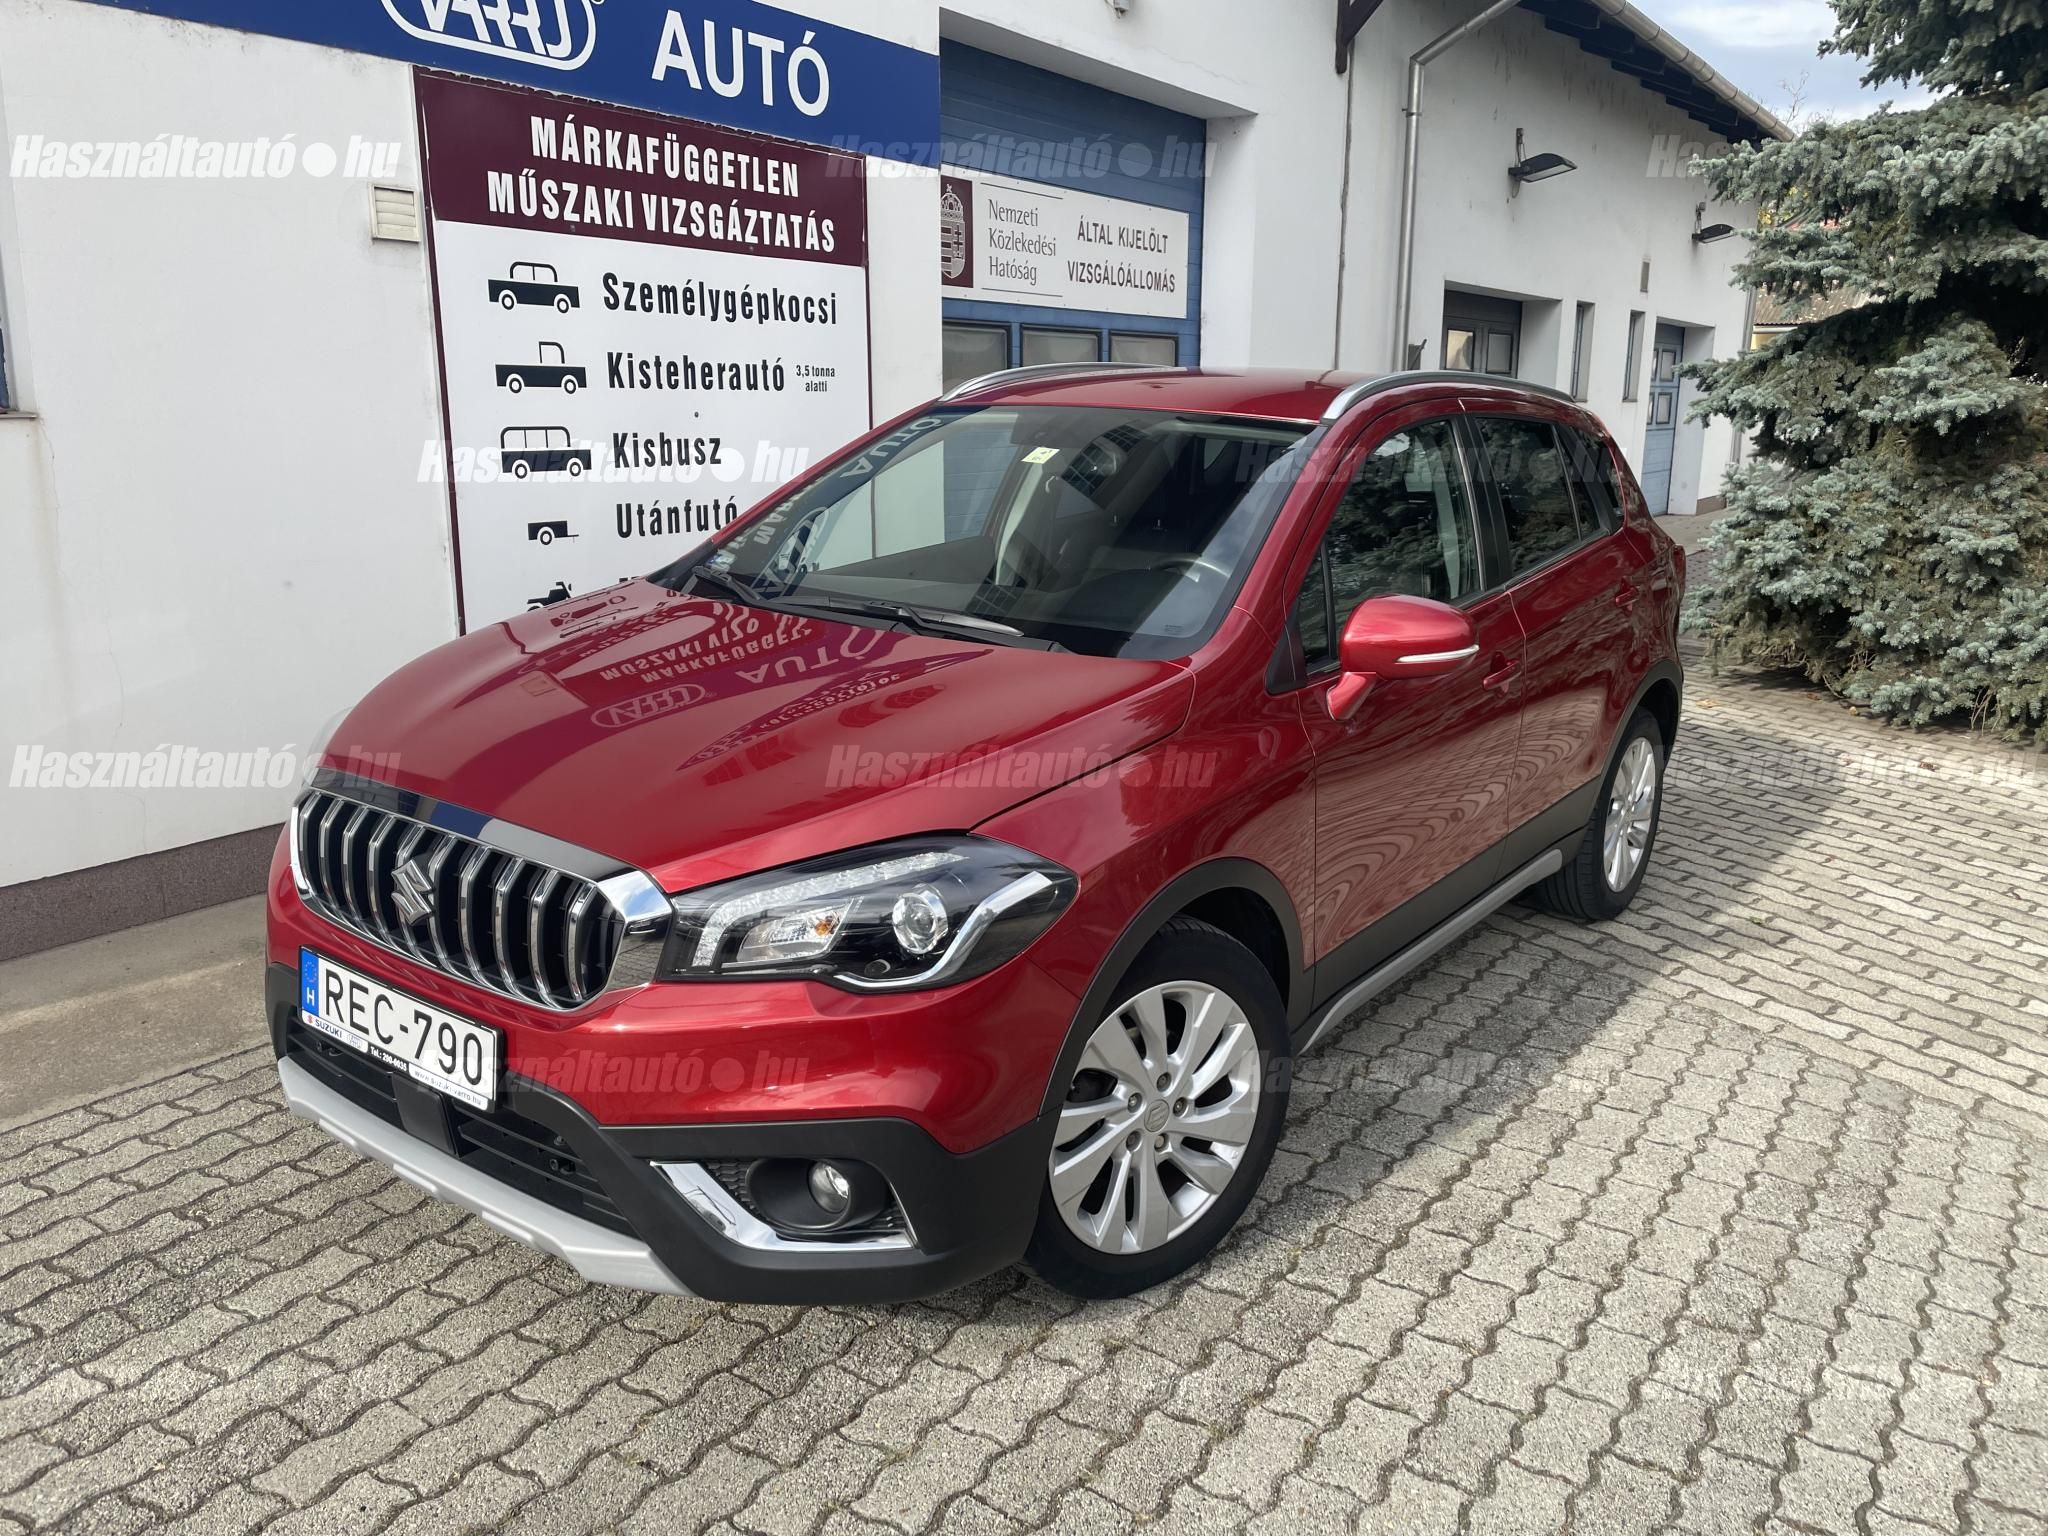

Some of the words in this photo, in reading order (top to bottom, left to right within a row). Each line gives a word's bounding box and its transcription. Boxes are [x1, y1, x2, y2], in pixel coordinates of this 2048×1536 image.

[651, 9, 830, 117] AUTÓ
[531, 116, 799, 198] MÁRKAFÜGGETLEN
[487, 168, 635, 230] MŰSZAKI
[642, 196, 835, 253] VIZSGÁZTATÁS
[988, 199, 1038, 227] Nemzeti
[988, 228, 1056, 257] Közlekedési
[1077, 215, 1113, 246] ÁLTAL
[1118, 226, 1168, 254] KIJELÖLT
[988, 256, 1037, 286] Hatóság
[1067, 260, 1176, 293] VIZSGÁLÓÁLLOMÁS
[602, 272, 837, 325] Személygépkocsi
[606, 351, 786, 392] Kisteherautó
[795, 364, 810, 379] 3,5
[811, 365, 836, 378] tonna
[805, 380, 828, 392] alatti
[612, 432, 722, 469] Kisbusz
[616, 495, 738, 539] Utánfutó
[306, 987, 315, 1007] H
[315, 1018, 343, 1039] SUZUKI
[325, 968, 483, 1086] REC-790
